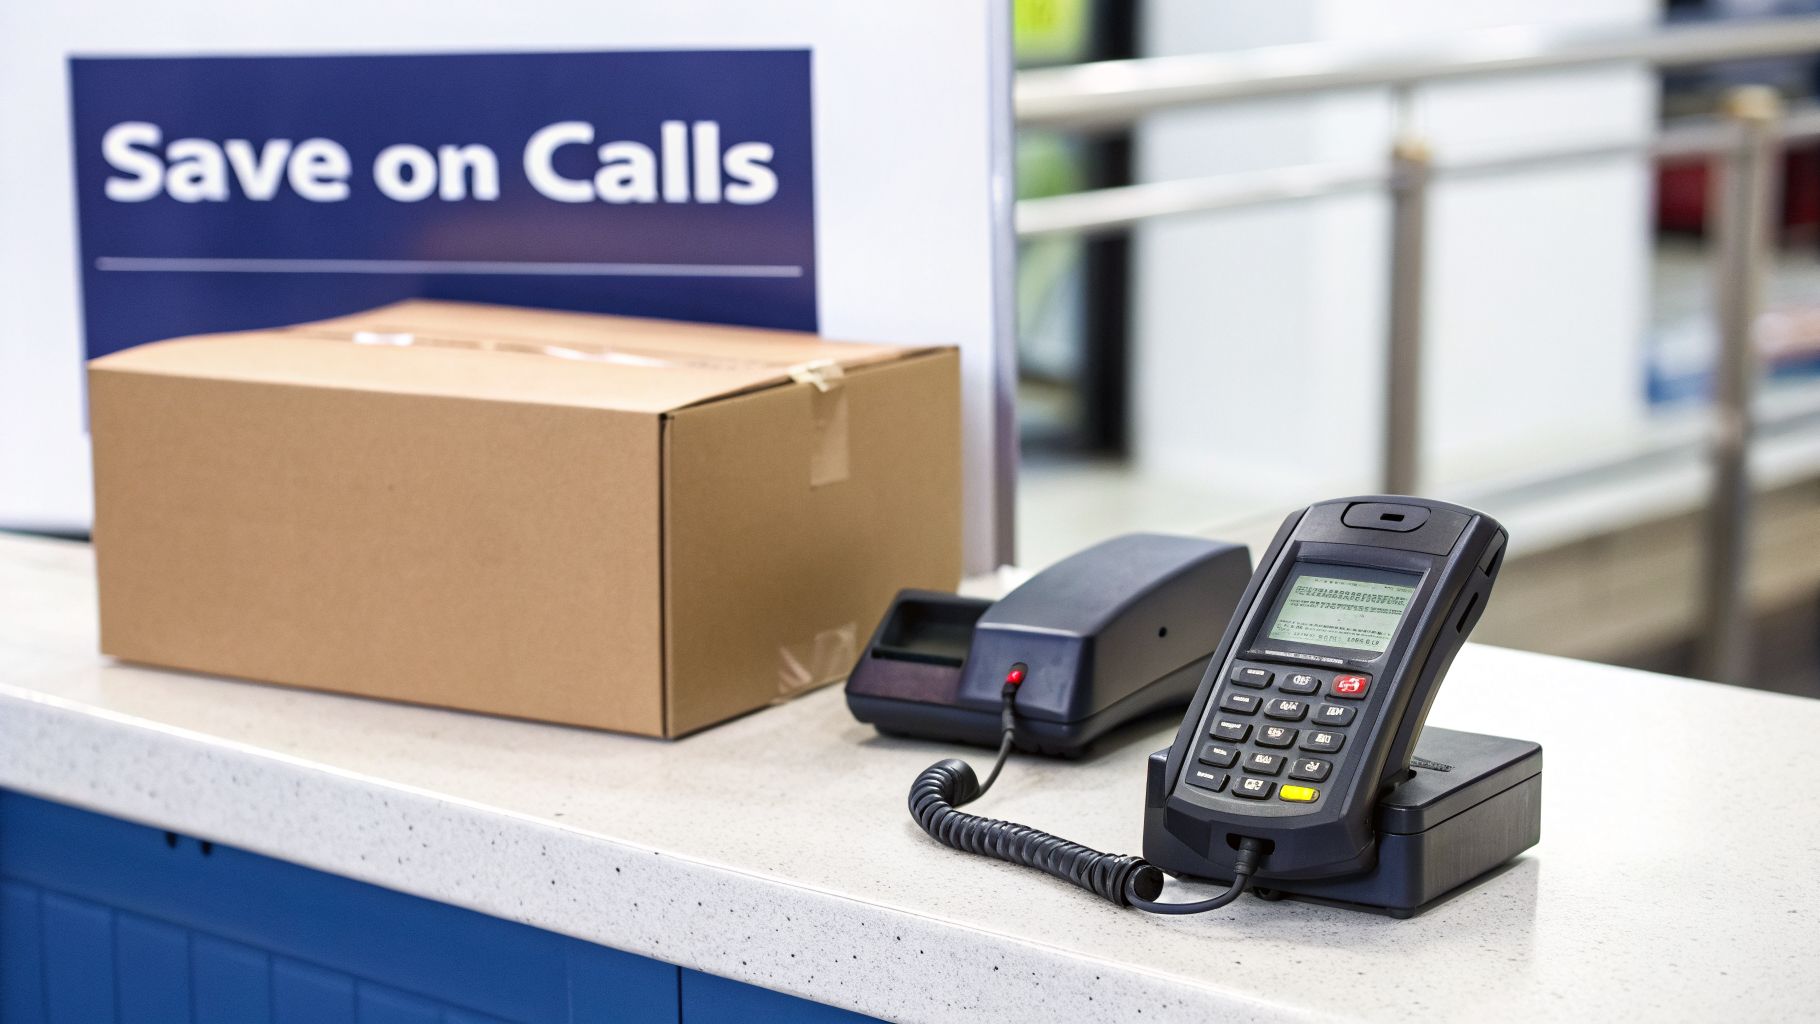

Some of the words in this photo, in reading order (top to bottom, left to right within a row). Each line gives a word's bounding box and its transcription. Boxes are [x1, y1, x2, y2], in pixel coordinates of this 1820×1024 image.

[103, 122, 350, 201] Save
[374, 144, 499, 200] on
[523, 121, 777, 203] Calls
